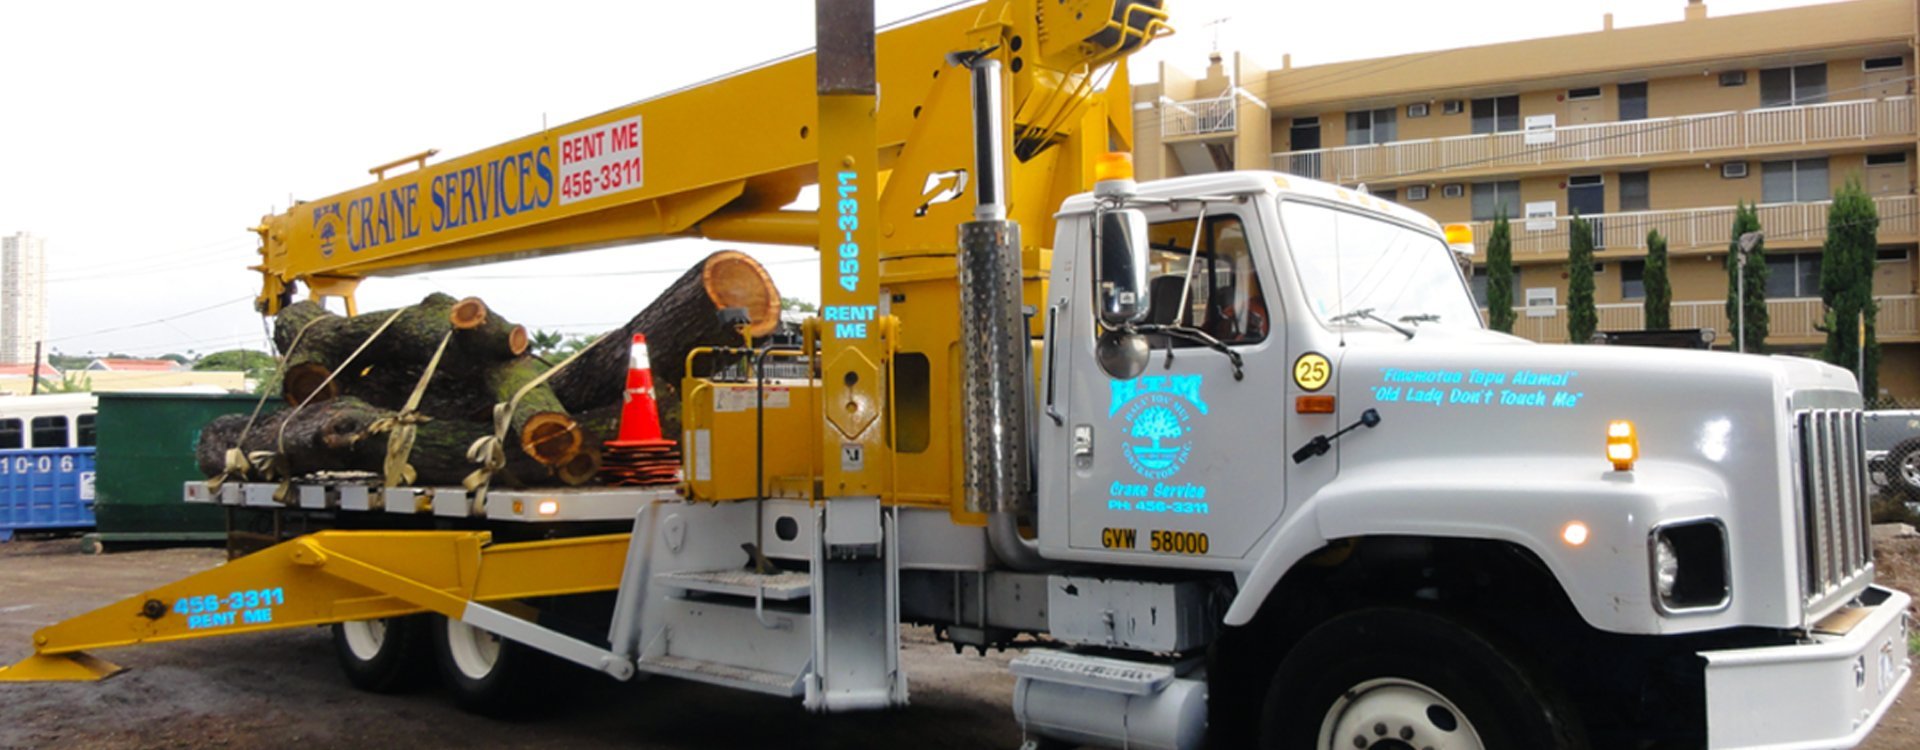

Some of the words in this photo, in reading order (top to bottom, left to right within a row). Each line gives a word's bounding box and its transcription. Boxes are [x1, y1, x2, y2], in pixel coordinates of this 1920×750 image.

[562, 130, 605, 165] RENT
[611, 121, 639, 153] ME
[561, 156, 641, 199] 456-3311
[346, 183, 422, 253] CRANE
[430, 145, 554, 233] SERVICES
[837, 171, 860, 292] 456-3311
[824, 305, 877, 321] RENT
[835, 323, 867, 339] ME
[1299, 361, 1325, 382] 25
[1468, 368, 1507, 388] Tapu
[1405, 386, 1445, 407] Lady
[1448, 387, 1495, 404] Don't
[1499, 388, 1547, 407] Touch
[1109, 480, 1149, 498] Crane
[1153, 481, 1207, 499] Service
[1134, 499, 1209, 515] 456-3311
[1101, 526, 1137, 549] GVW
[1150, 529, 1209, 555] 58000
[173, 587, 285, 615] 456-3311
[187, 610, 237, 630] RENT
[243, 607, 273, 624] ME
